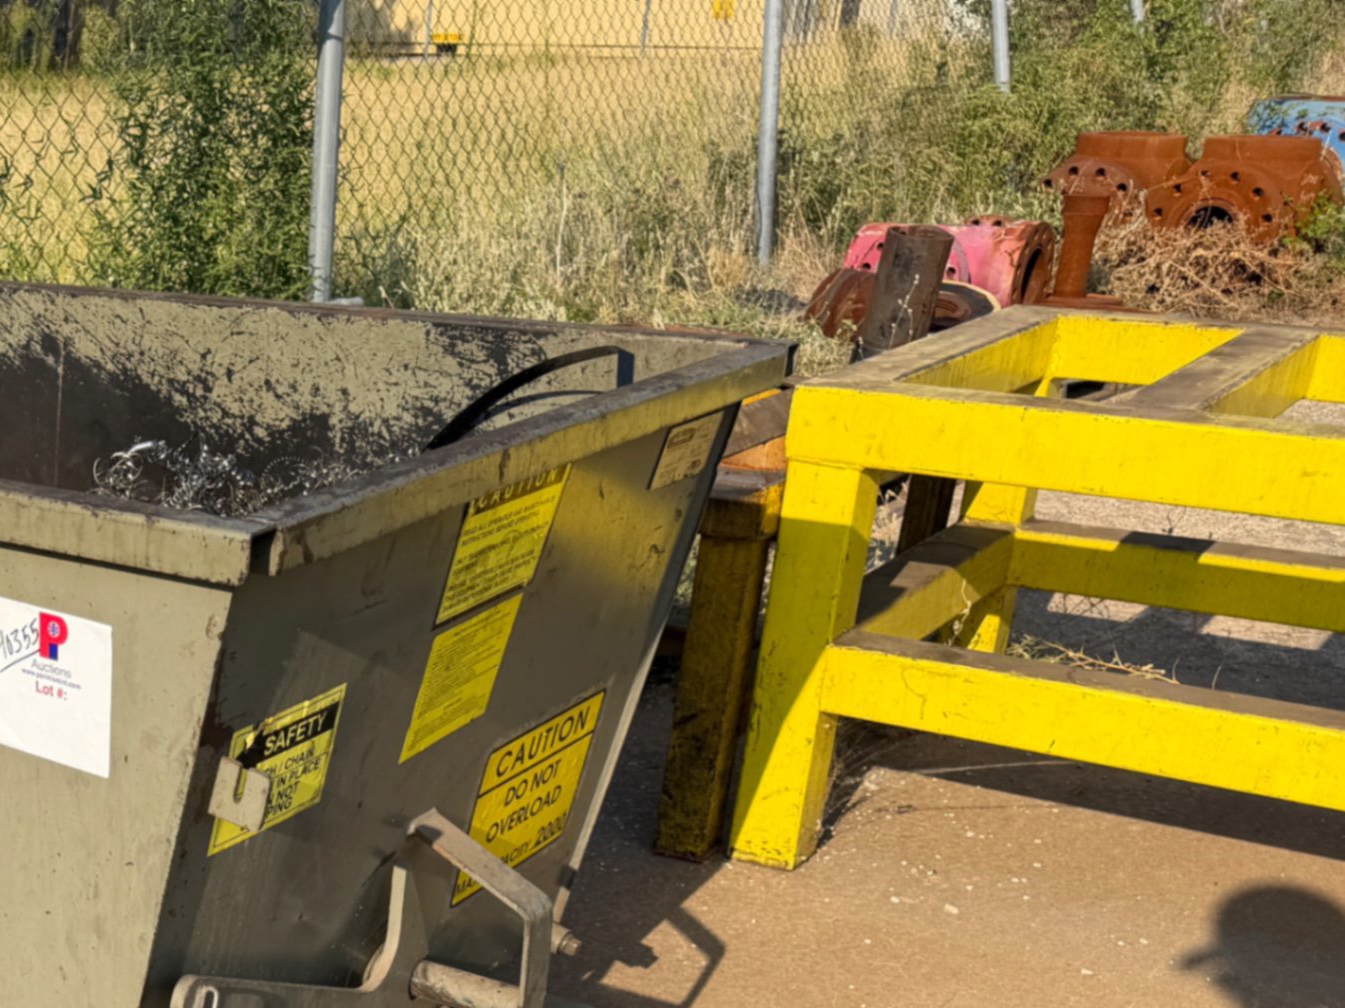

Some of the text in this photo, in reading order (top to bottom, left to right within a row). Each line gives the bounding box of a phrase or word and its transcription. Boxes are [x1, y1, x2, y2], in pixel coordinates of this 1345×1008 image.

[35, 680, 54, 697] Lot
[264, 710, 328, 756] SAFETY
[496, 706, 590, 779] CAUTION
[285, 747, 315, 769] CHAIN
[289, 757, 321, 780] PLACE
[277, 781, 300, 801] NOT
[504, 759, 562, 807] DO NOT
[485, 785, 562, 843] OVERLOAD
